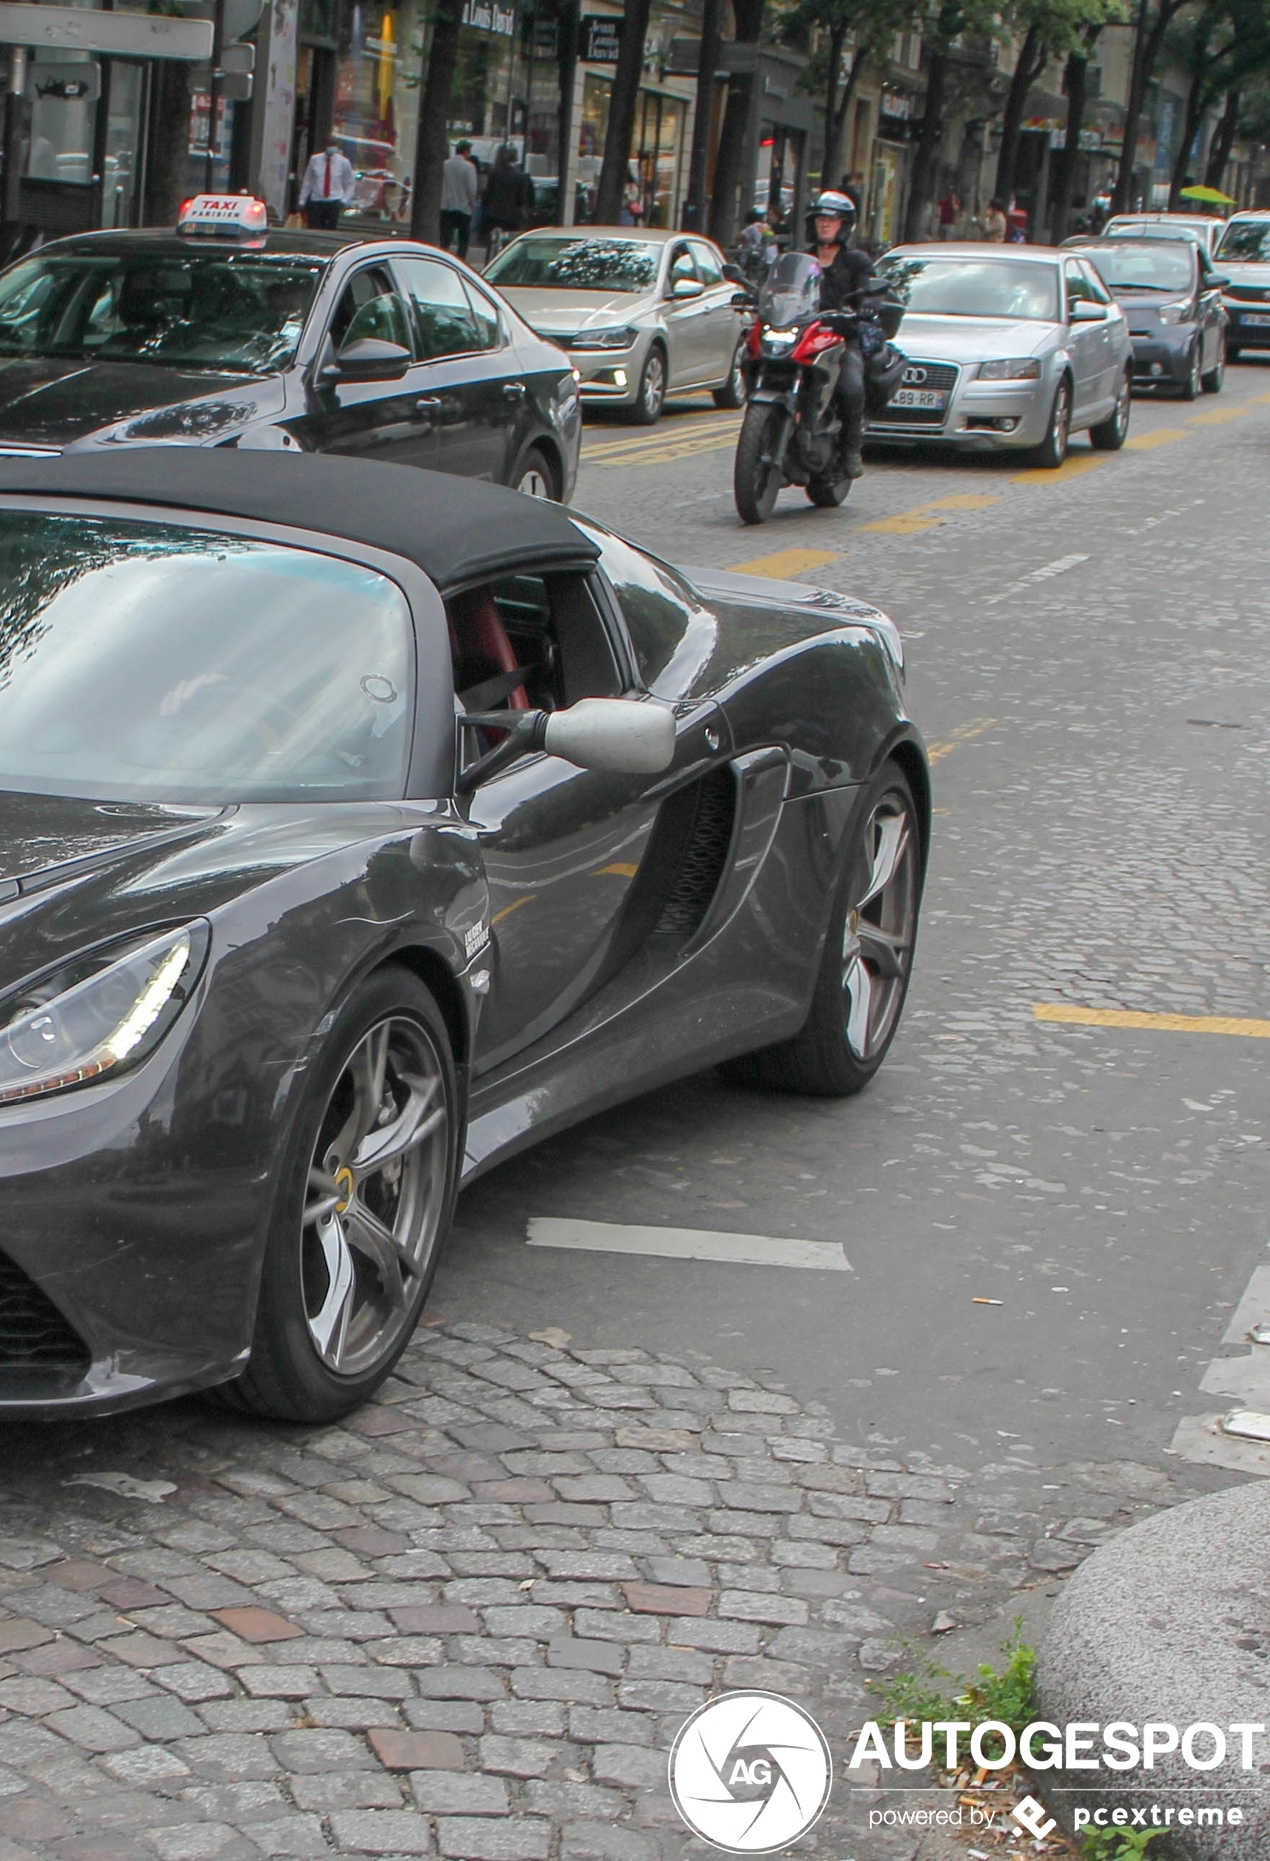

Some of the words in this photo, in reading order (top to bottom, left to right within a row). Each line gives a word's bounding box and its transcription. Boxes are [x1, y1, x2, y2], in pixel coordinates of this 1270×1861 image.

[491, 3, 514, 35] David
[202, 201, 238, 210] TAXI
[191, 210, 240, 218] PARISIEN
